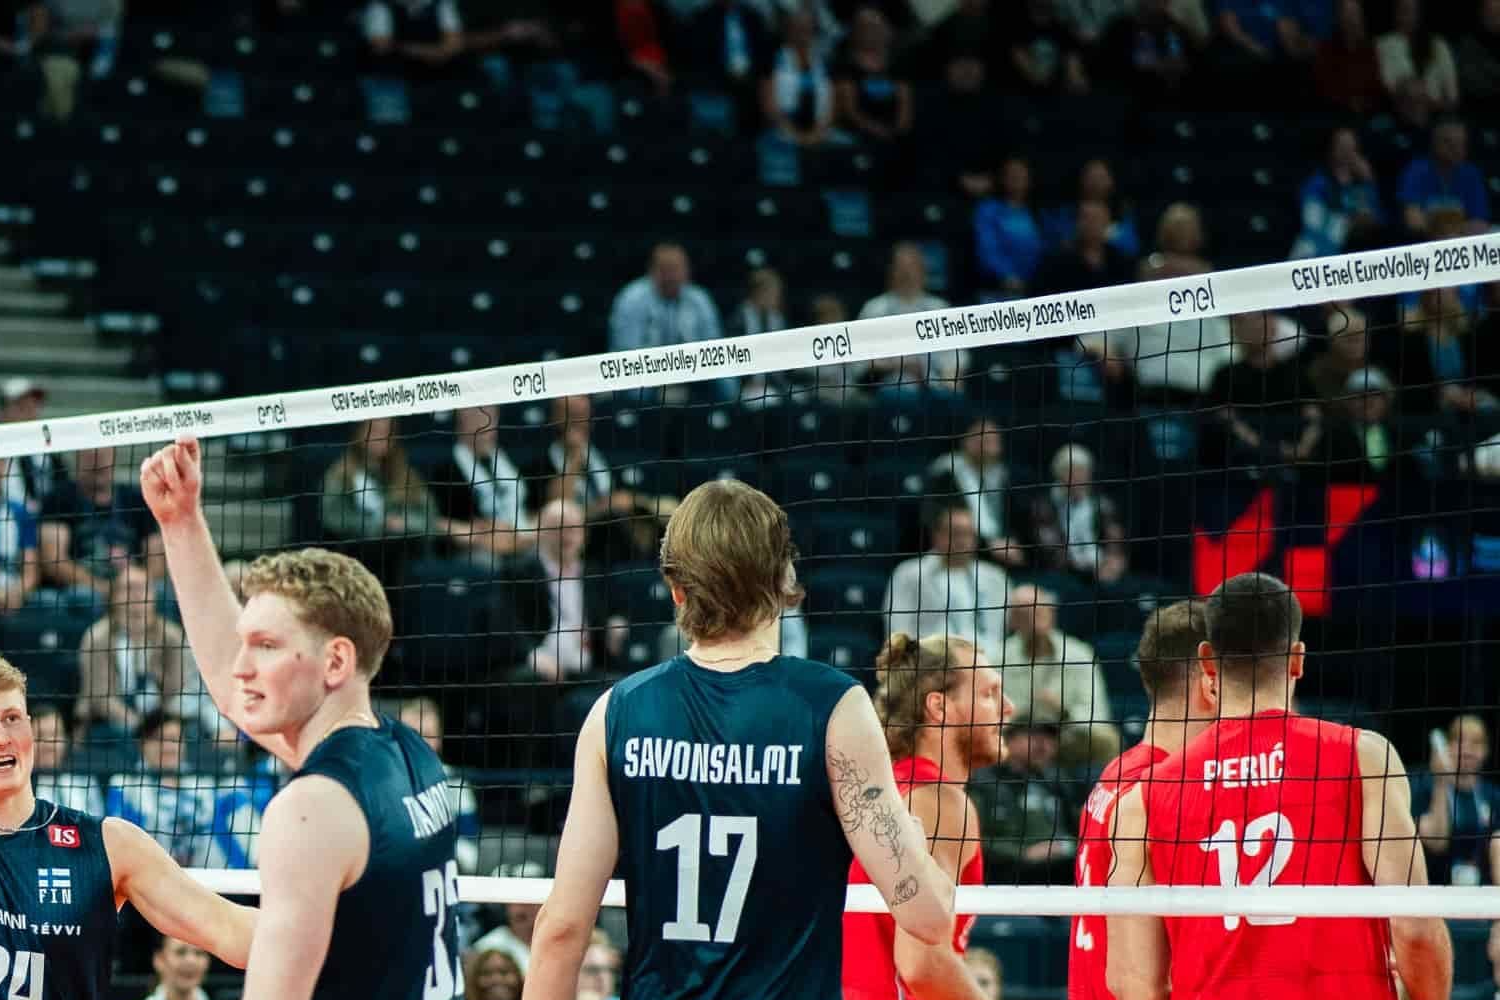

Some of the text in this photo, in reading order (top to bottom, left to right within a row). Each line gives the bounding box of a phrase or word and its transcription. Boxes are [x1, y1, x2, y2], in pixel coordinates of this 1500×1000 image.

[1291, 266, 1320, 291] CEV
[1323, 261, 1354, 287] Enel
[1355, 252, 1430, 281] EuroVolley
[1434, 248, 1470, 273] 2026
[1168, 278, 1216, 315] enel
[915, 299, 1096, 340] CEV Enel EuroVolley 2026 Men
[600, 344, 751, 380] CEV Enel EuroVolley 2026 Men
[812, 327, 852, 360] enel
[331, 379, 460, 411] CEV Enel EuroVolley 2026 Men
[512, 367, 546, 396] enel
[624, 737, 803, 785] SAVONSALMI
[1203, 742, 1285, 791] PERIĆ
[53, 827, 76, 845] IS
[655, 813, 758, 944] 17
[1199, 811, 1299, 931] 12
[39, 888, 72, 905] FIN
